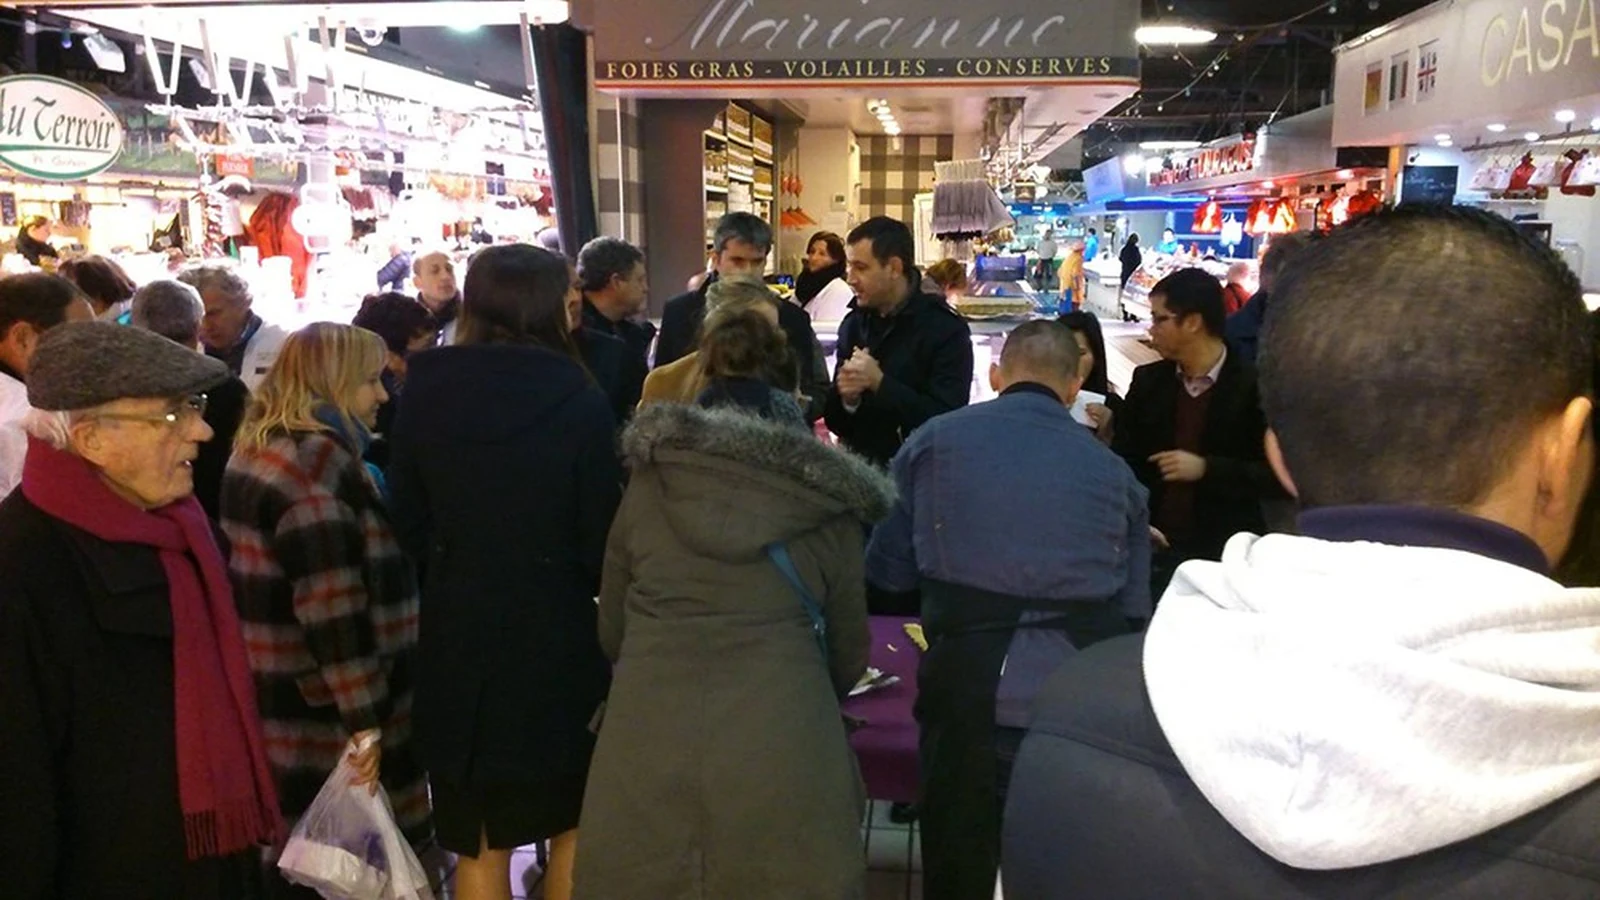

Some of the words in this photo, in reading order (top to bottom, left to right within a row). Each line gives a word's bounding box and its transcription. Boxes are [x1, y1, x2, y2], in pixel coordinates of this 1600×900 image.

[607, 62, 679, 79] FOIES
[689, 61, 754, 78] GRAS
[784, 60, 926, 77] VOLAILLES
[956, 57, 1111, 76] CONSERVES
[1481, 0, 1600, 87] CASA
[32, 96, 115, 148] Terroir
